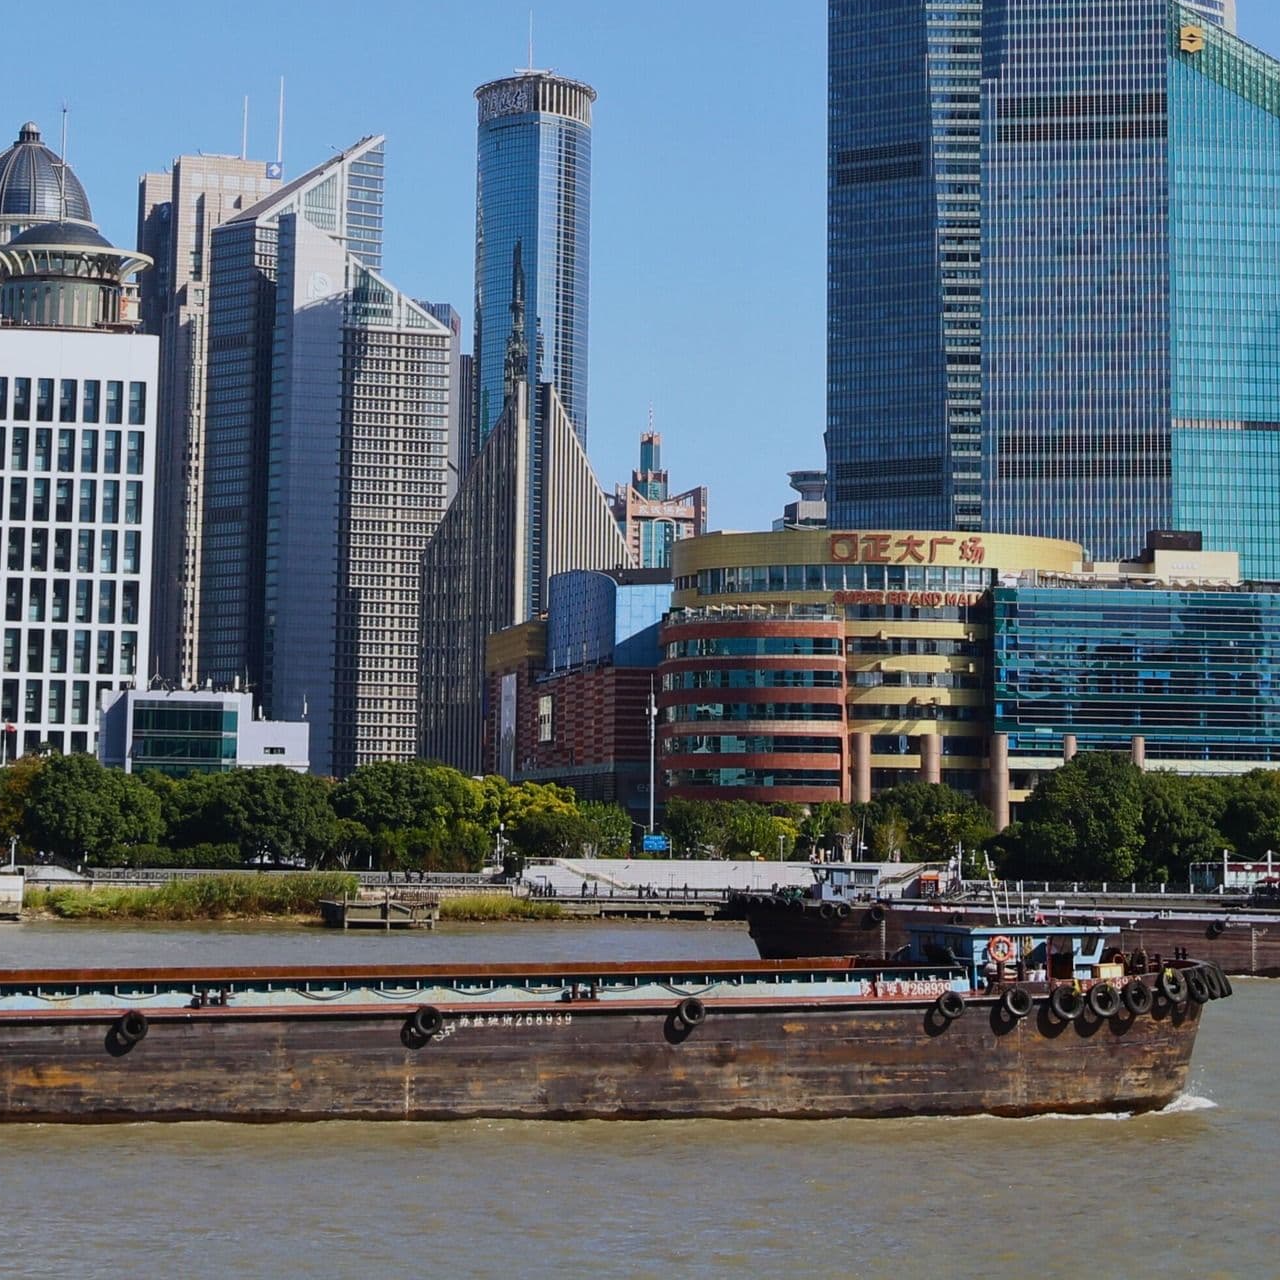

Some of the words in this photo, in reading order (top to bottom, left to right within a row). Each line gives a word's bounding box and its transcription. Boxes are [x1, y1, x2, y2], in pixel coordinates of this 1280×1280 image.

[860, 534, 985, 564] 正大广场
[834, 591, 884, 606] SUPER
[887, 591, 943, 607] BRAND
